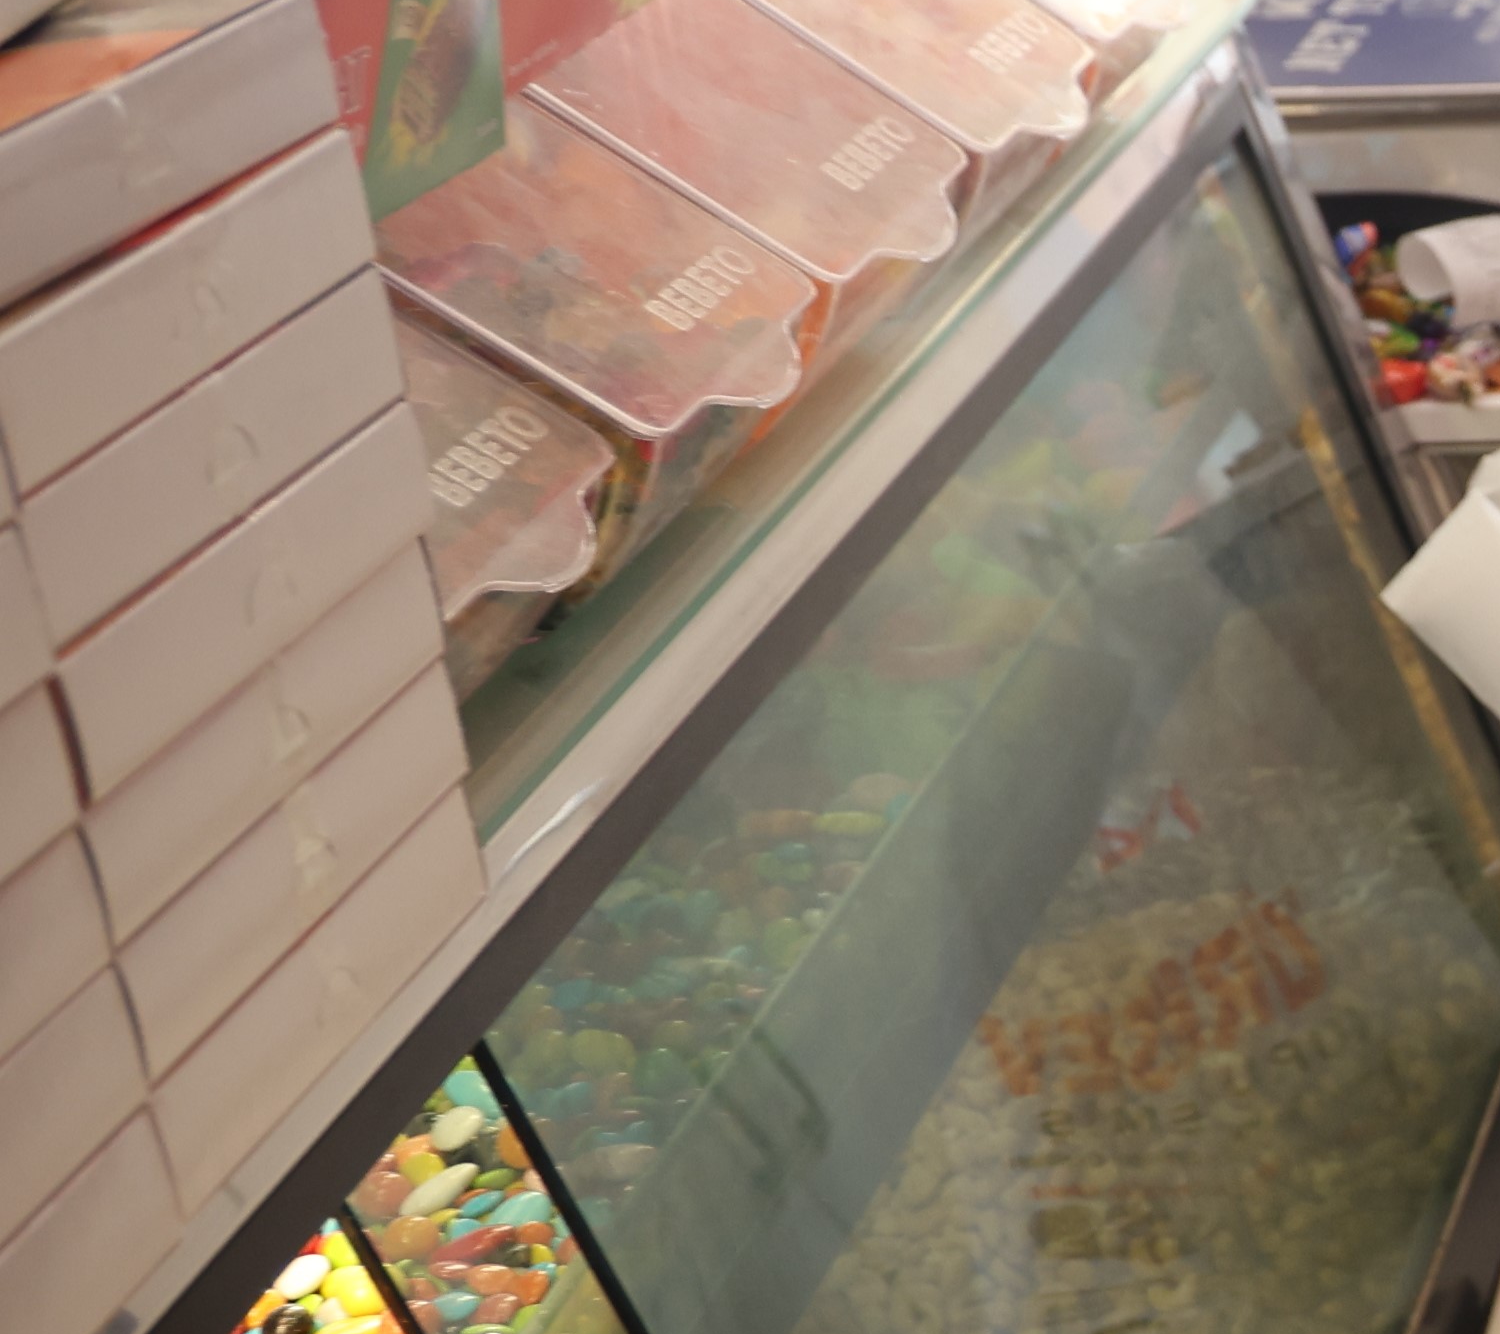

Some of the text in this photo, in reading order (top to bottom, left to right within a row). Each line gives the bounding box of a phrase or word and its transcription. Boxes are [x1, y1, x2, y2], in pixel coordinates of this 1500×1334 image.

[820, 114, 917, 193] BEBETO
[643, 245, 759, 334] BEBETO
[430, 402, 549, 508] BEBETO
